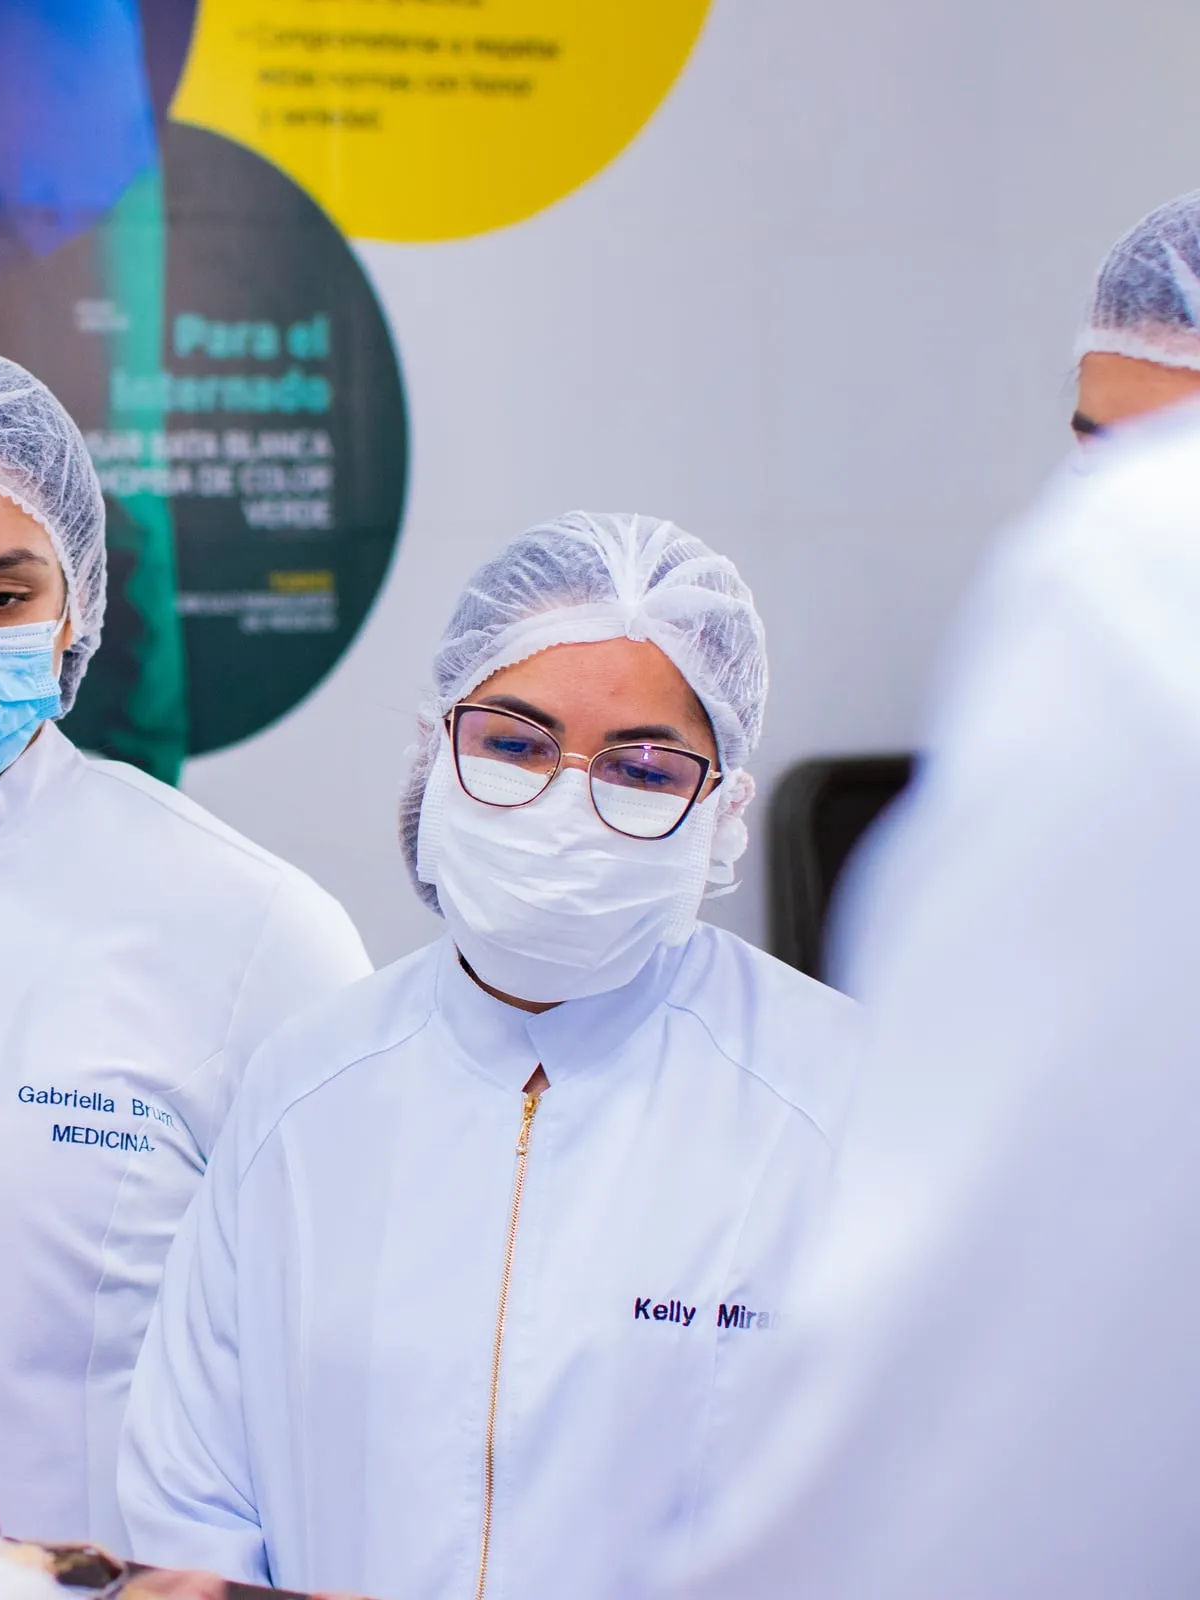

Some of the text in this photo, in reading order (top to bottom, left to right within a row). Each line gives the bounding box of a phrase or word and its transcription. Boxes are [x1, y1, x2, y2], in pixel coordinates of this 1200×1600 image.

[174, 313, 279, 358] Para
[287, 315, 329, 358] el
[111, 367, 331, 411] Internado
[222, 430, 334, 461] BLANCA
[197, 466, 234, 496] DE
[238, 466, 334, 497] COLOR
[241, 499, 334, 530] VERDE
[18, 1085, 115, 1113] Gabriella
[633, 1297, 697, 1327] Kelly
